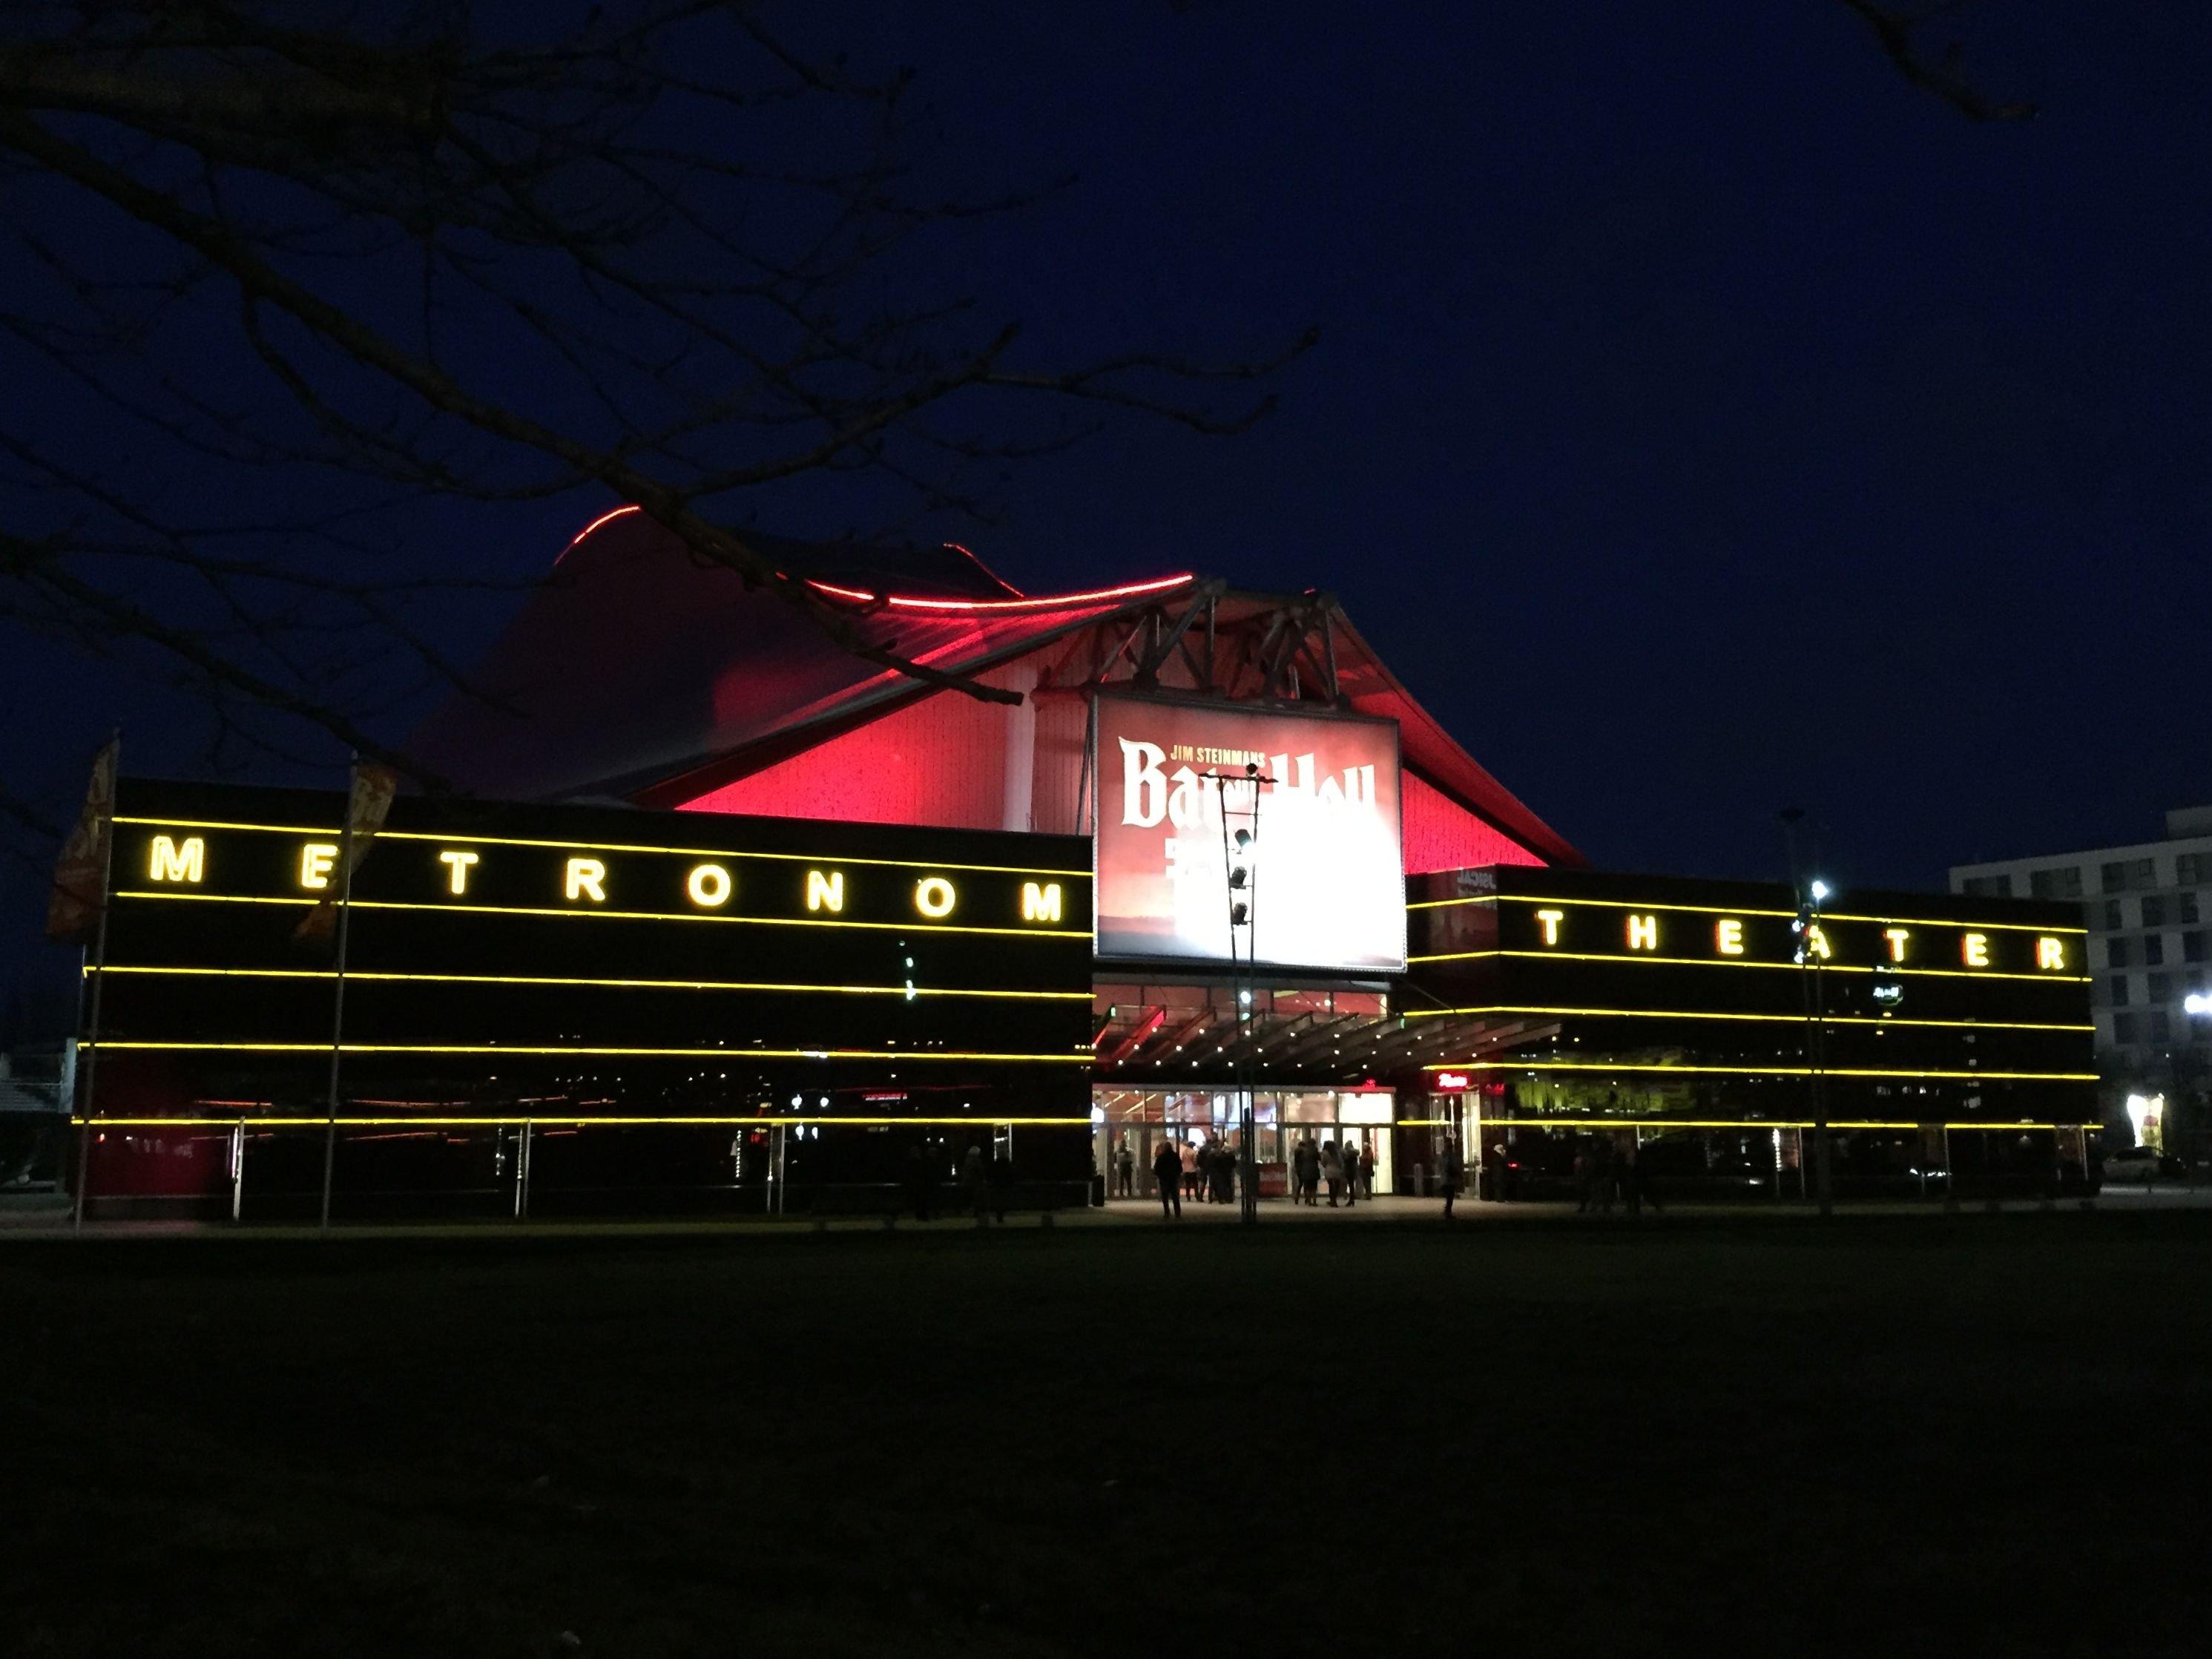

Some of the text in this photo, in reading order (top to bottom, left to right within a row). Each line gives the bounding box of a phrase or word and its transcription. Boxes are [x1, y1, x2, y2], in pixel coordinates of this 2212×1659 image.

[1119, 735, 1222, 832] Bat
[1170, 744, 1266, 768] JIM STEINMANS
[148, 835, 1061, 922] METRONOM
[1536, 910, 2065, 970] THEATER
